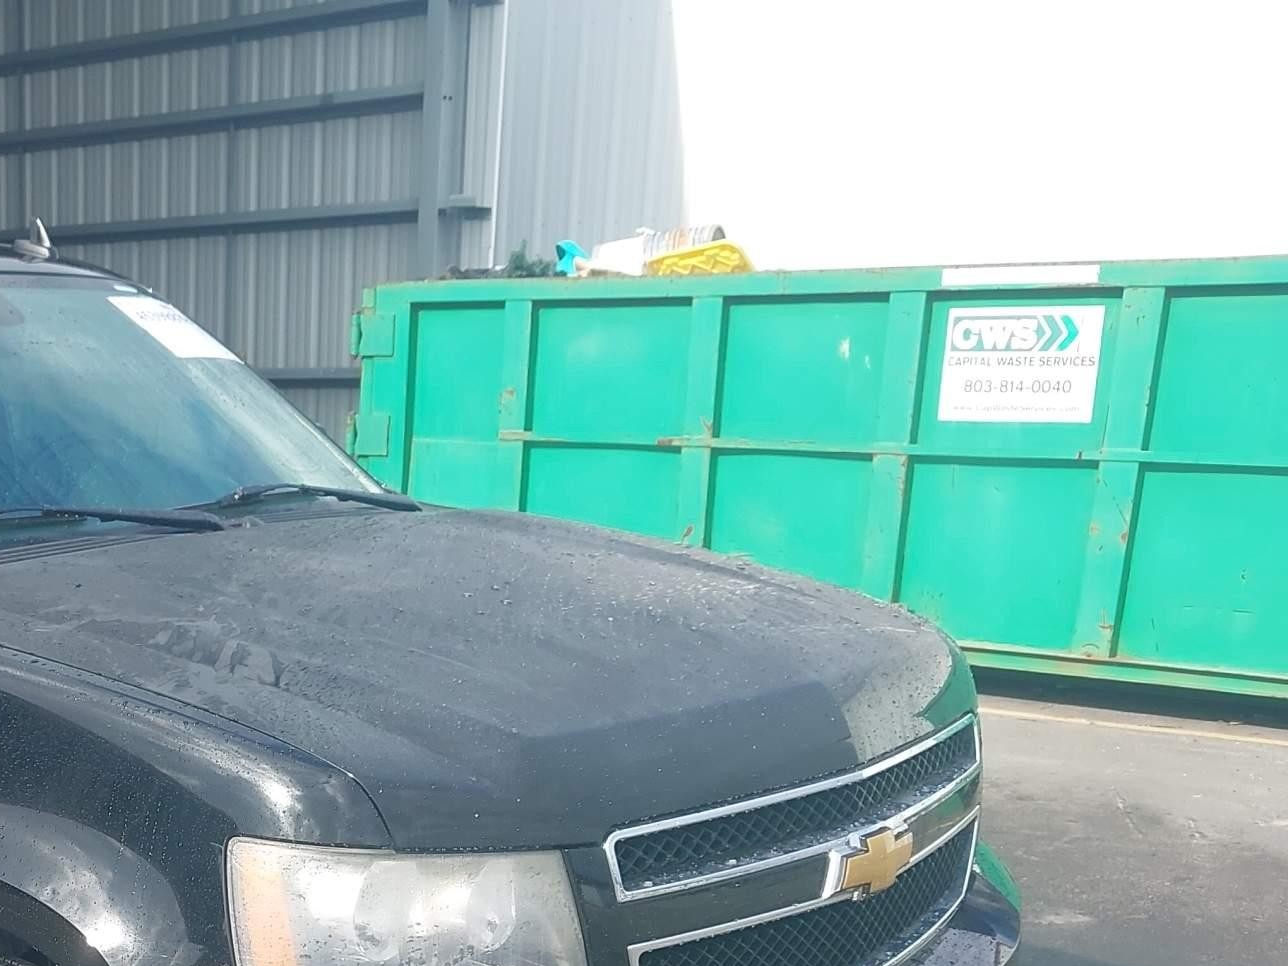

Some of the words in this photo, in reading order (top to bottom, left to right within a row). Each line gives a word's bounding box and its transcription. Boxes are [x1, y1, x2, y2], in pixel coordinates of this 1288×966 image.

[952, 317, 1040, 351] CWS
[948, 356, 992, 367] CAPITAL
[996, 356, 1036, 367] WASTE
[1038, 356, 1097, 367] SERVICES
[962, 379, 1073, 394] 803-814-0040
